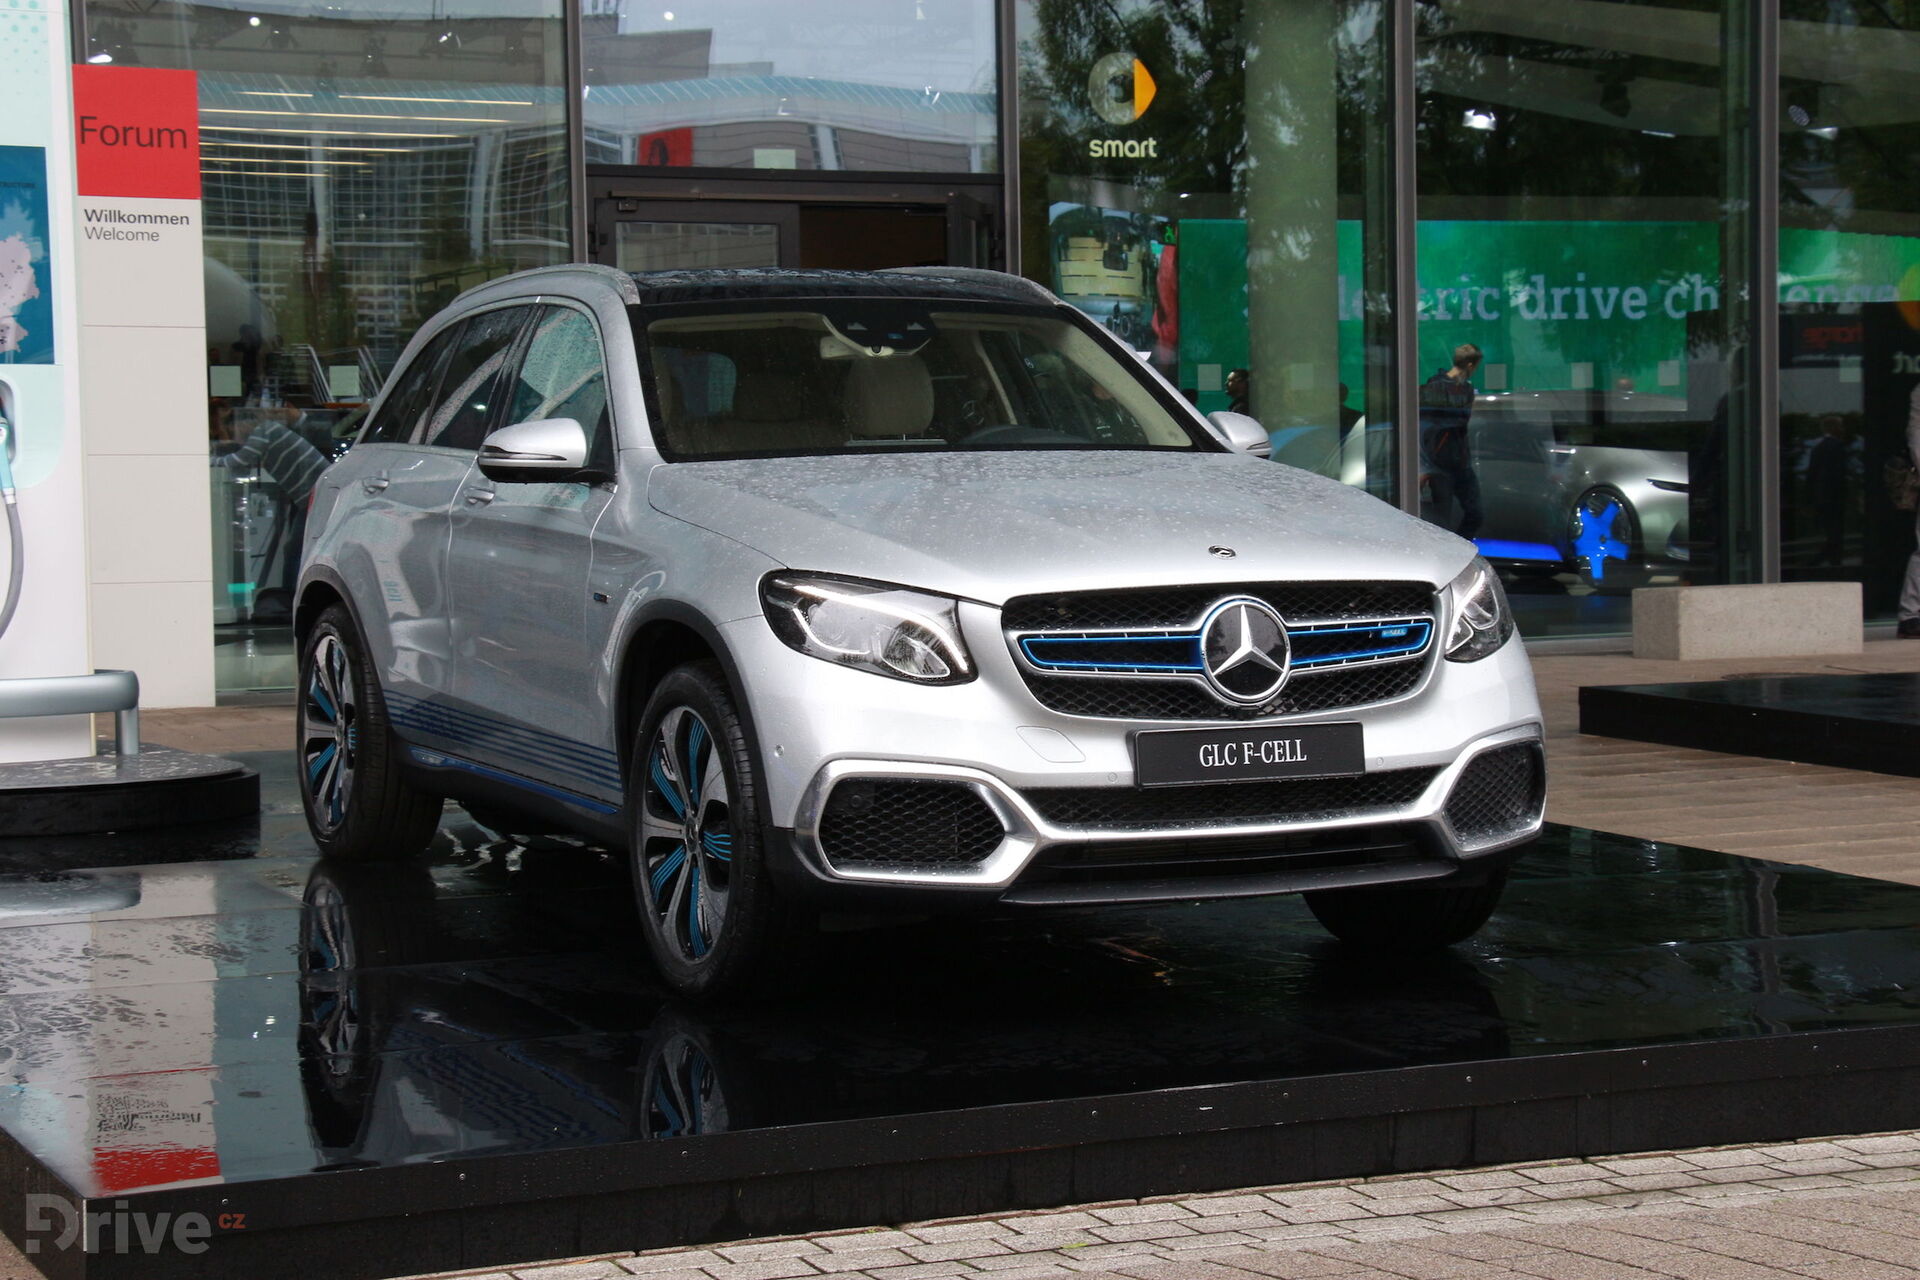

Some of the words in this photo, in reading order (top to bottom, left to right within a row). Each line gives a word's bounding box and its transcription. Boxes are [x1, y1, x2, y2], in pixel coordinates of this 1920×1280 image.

[79, 115, 188, 149] Forum
[1089, 137, 1158, 158] smart
[84, 208, 190, 225] Willkommen
[84, 226, 160, 241] Welcome
[1517, 273, 1648, 320] drive
[1199, 743, 1238, 767] GLC
[1242, 739, 1307, 765] F-CELL
